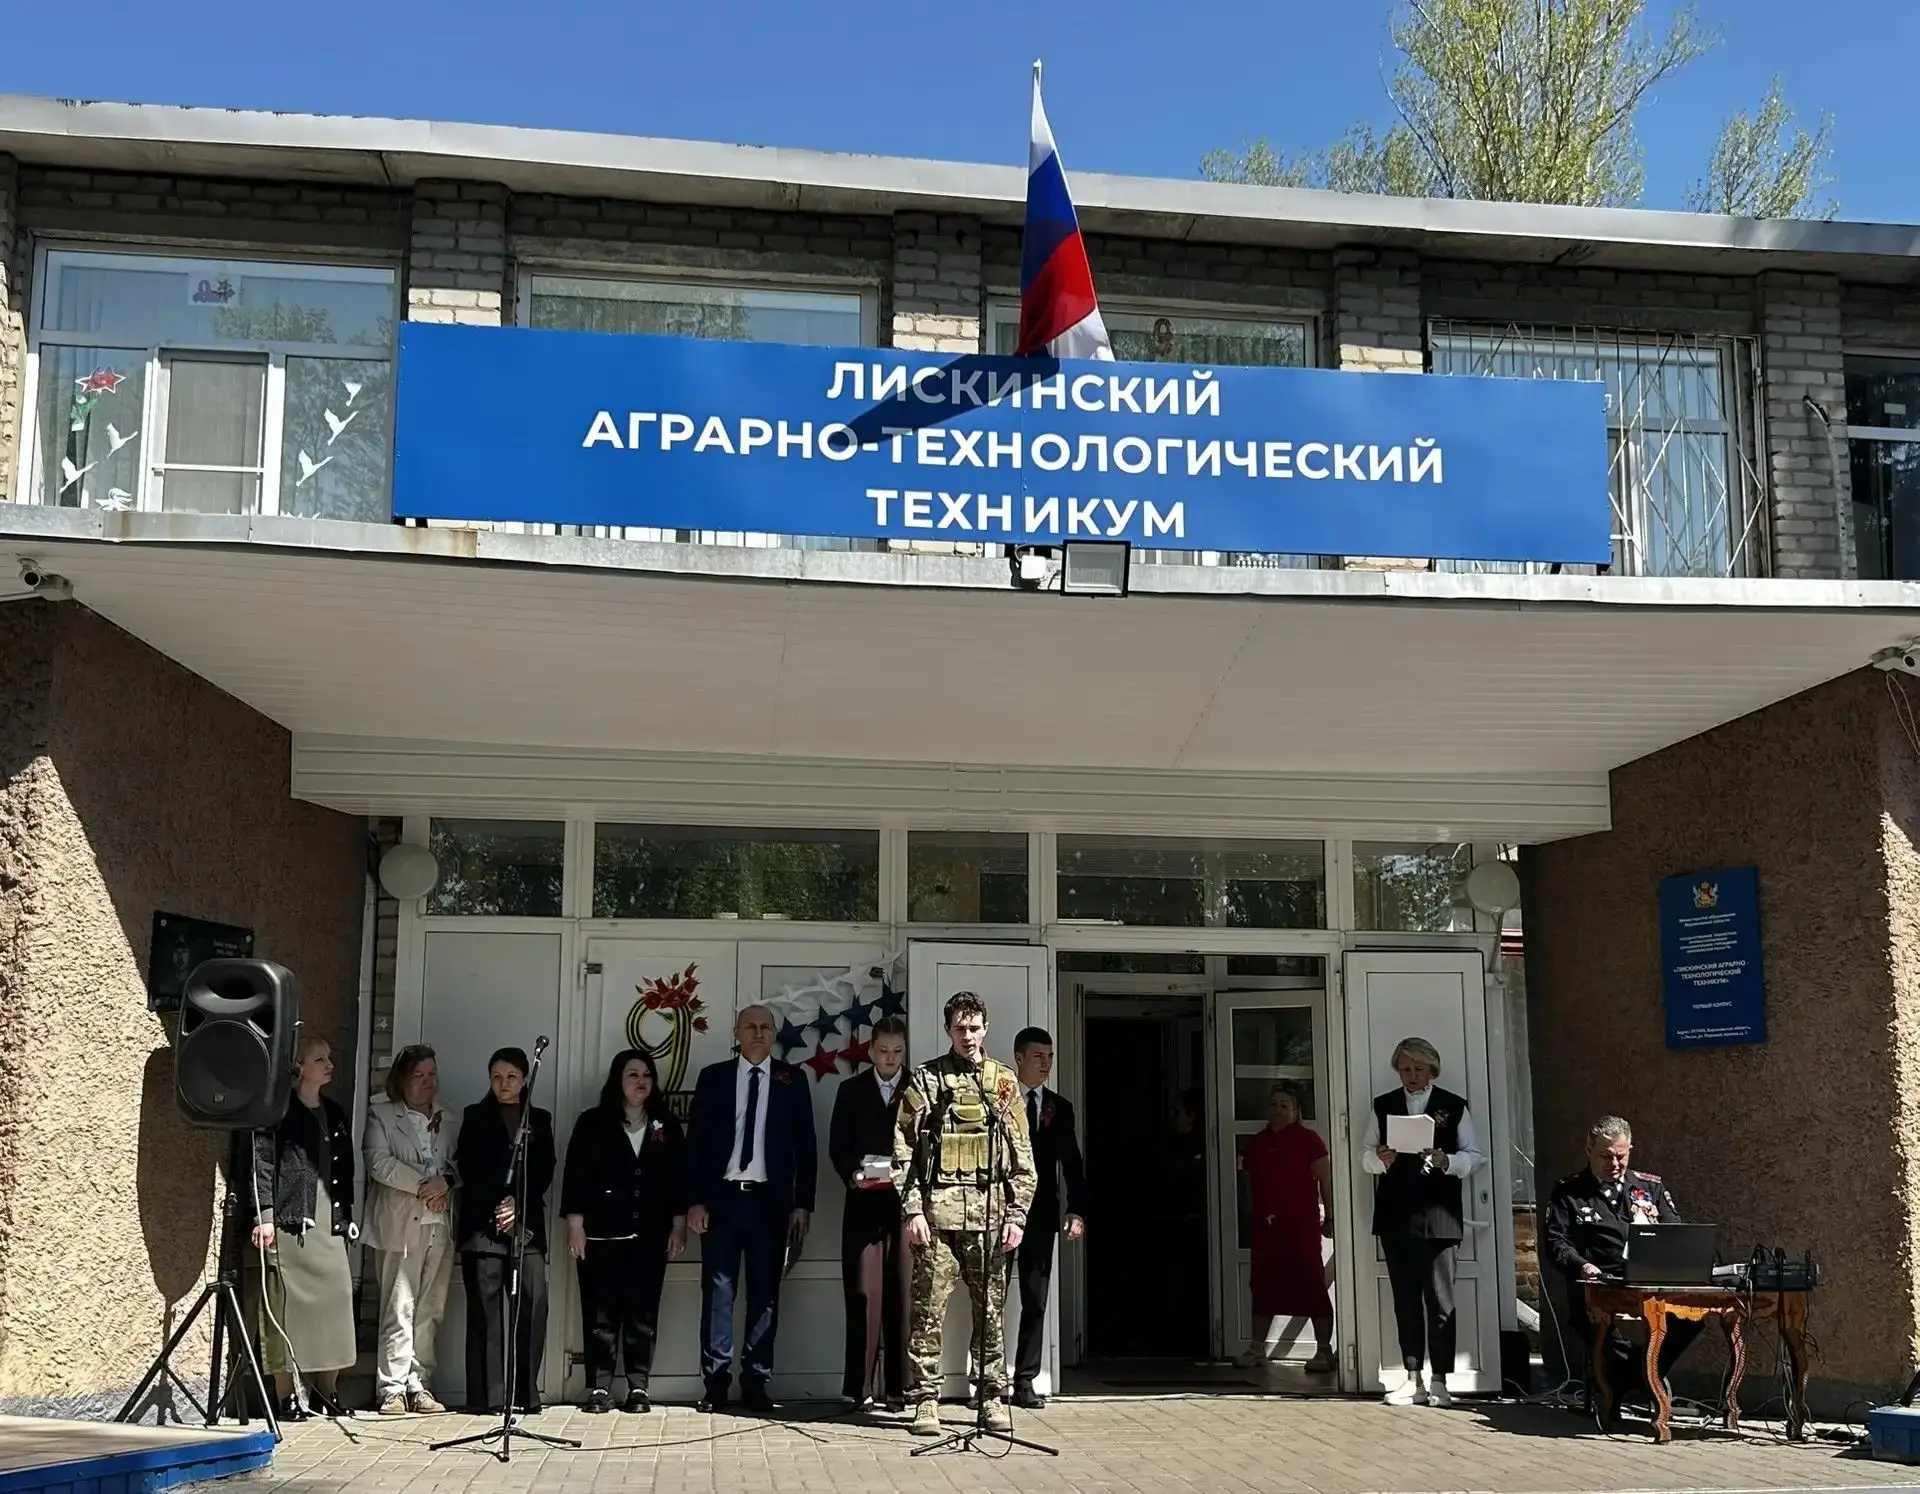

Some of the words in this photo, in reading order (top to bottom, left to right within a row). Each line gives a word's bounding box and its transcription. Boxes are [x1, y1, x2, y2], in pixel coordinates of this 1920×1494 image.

[827, 361, 1219, 416] ЛИСКИНСКИЙ
[583, 410, 1442, 484] АГРАРНО-ТЕХНОЛОГИЧЕСКИЙ
[865, 488, 1185, 539] ТЕХНИКУМ
